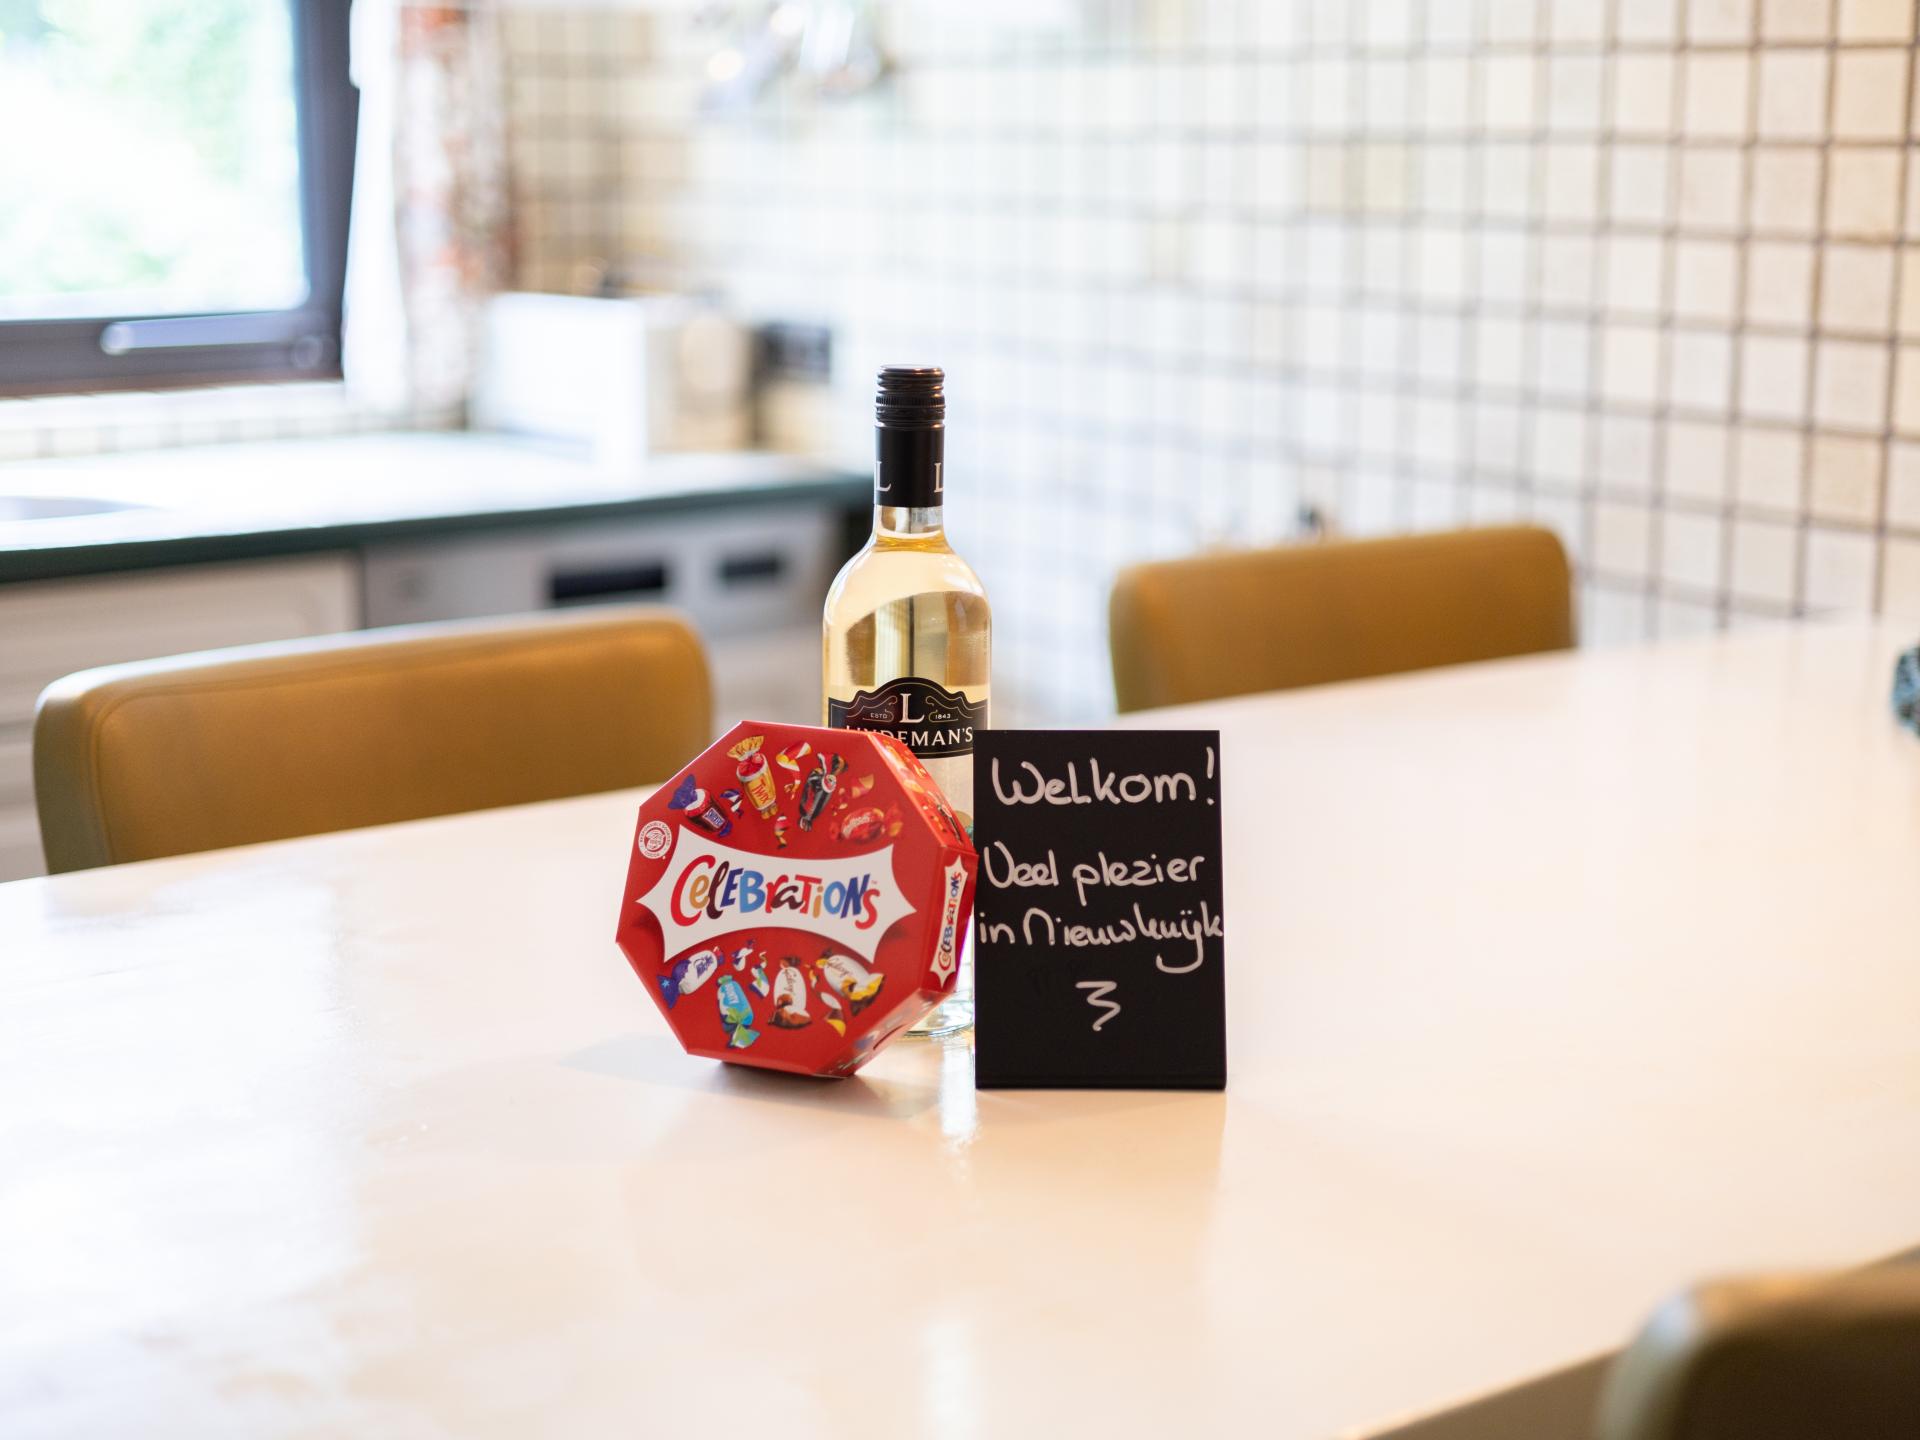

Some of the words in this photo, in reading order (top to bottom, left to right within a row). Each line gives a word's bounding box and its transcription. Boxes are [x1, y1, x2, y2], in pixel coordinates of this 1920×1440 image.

[899, 693, 925, 723] L
[984, 840, 1060, 889] Veel
[1072, 851, 1206, 907] plezier
[979, 911, 1016, 944] in
